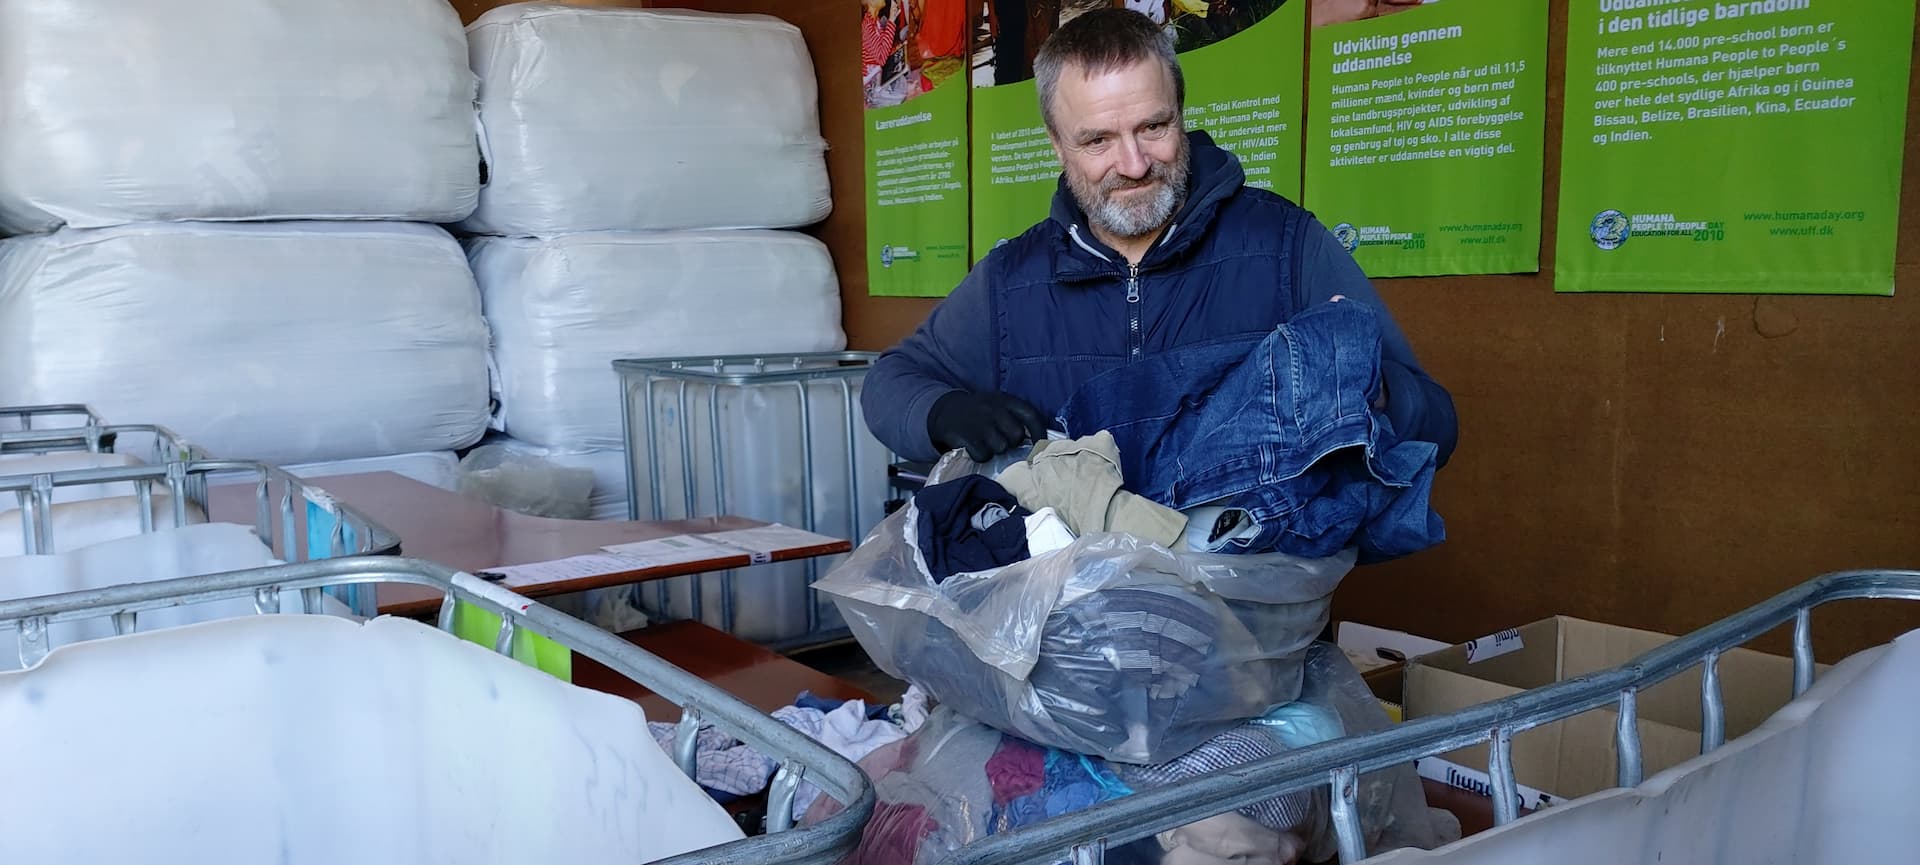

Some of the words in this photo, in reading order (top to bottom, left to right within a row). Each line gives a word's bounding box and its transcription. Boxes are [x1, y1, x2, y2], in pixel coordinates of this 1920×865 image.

[1599, 19, 1604, 34] i
[1608, 16, 1642, 33] den
[1647, 8, 1709, 28] tidlige
[1714, 0, 1810, 20] barndom
[1333, 35, 1398, 56] Udvikling
[1401, 26, 1462, 48] gennem
[1597, 47, 1628, 58] Mere
[1631, 42, 1654, 54] end
[1659, 36, 1699, 51] 14.000
[1702, 27, 1776, 49] pre-school
[1779, 25, 1814, 38] børn
[1817, 23, 1834, 33] er
[1333, 51, 1412, 74] uddannelse
[1596, 60, 1652, 75] tilknyttet
[1655, 55, 1709, 69] Humana
[1712, 48, 1759, 64] People
[1762, 48, 1776, 58] to
[1332, 83, 1369, 94] Humana
[1371, 78, 1402, 89] People
[1404, 76, 1414, 85] to
[1415, 71, 1451, 83] People
[1453, 67, 1472, 79] når
[1474, 65, 1488, 77] ud
[1490, 64, 1501, 74] til
[1504, 60, 1525, 73] 11,5
[1595, 80, 1617, 92] 400
[1620, 73, 1698, 93] pre-schools,
[1702, 71, 1725, 82] der
[1728, 66, 1783, 82] hjælper
[1785, 63, 1819, 74] børn
[1231, 96, 1261, 109] Kontrol
[1262, 94, 1280, 105] med
[1332, 97, 1373, 109] millioner
[1375, 91, 1405, 104] mænd,
[1408, 87, 1445, 99] kvinder
[1448, 86, 1461, 97] og
[1463, 84, 1489, 93] børn
[1491, 78, 1514, 90] med
[1595, 99, 1622, 109] over
[1624, 95, 1651, 107] hele
[1654, 93, 1674, 104] det
[1678, 88, 1724, 104] sydlige
[1727, 84, 1770, 97] Afrika
[1773, 84, 1790, 96] og
[1794, 80, 1798, 92] i
[1802, 78, 1853, 91] Guinea
[1205, 116, 1218, 127] har
[1220, 113, 1251, 125] Humana
[1252, 108, 1280, 121] People
[1331, 114, 1350, 123] sine
[1352, 104, 1445, 121] landbrugsprojekter,
[1448, 98, 1497, 110] udvikling
[1500, 95, 1510, 105] af
[1594, 115, 1637, 126] Bissau,
[1641, 110, 1683, 123] Belize,
[1687, 104, 1751, 119] Brasilien,
[1755, 102, 1790, 113] Kina,
[1794, 96, 1856, 111] Ecuador
[1219, 127, 1227, 138] år
[1229, 125, 1265, 137] undervist
[1266, 123, 1288, 133] mere
[1331, 123, 1394, 137] lokalsamfund,
[1397, 120, 1412, 131] HIV
[1414, 121, 1426, 131] og
[1428, 116, 1453, 128] AIDS
[1456, 111, 1523, 125] forebyggelse
[1242, 137, 1279, 150] HIV/AIDS
[1330, 145, 1341, 154] og
[1343, 140, 1381, 153] genbrug
[1382, 137, 1392, 147] af
[1394, 136, 1405, 148] tøj
[1407, 137, 1418, 147] og
[1420, 134, 1441, 144] sko.
[1444, 132, 1448, 141] I
[1450, 131, 1471, 141] alle
[1473, 129, 1501, 140] disse
[1593, 134, 1607, 145] og
[1611, 130, 1652, 142] Indien.
[1251, 151, 1277, 161] Indien
[1330, 155, 1376, 166] aktiviteter
[1390, 148, 1446, 161] uddannelse
[1448, 149, 1462, 157] en
[1464, 145, 1494, 157] vigtig
[1496, 144, 1514, 153] del.
[1243, 165, 1270, 176] umana
[1631, 214, 1675, 223] HUMANA
[1743, 209, 1865, 222] www.humanaday.org
[1360, 225, 1391, 234] HUMANA
[1631, 223, 1660, 231] PEOPLE
[1663, 222, 1674, 231] TO
[1675, 222, 1707, 230] PEOPLE
[1667, 229, 1680, 237] FOR
[1694, 229, 1725, 242] 2010
[1769, 225, 1833, 236] www.uff.dk
[1403, 240, 1425, 250] 2010
